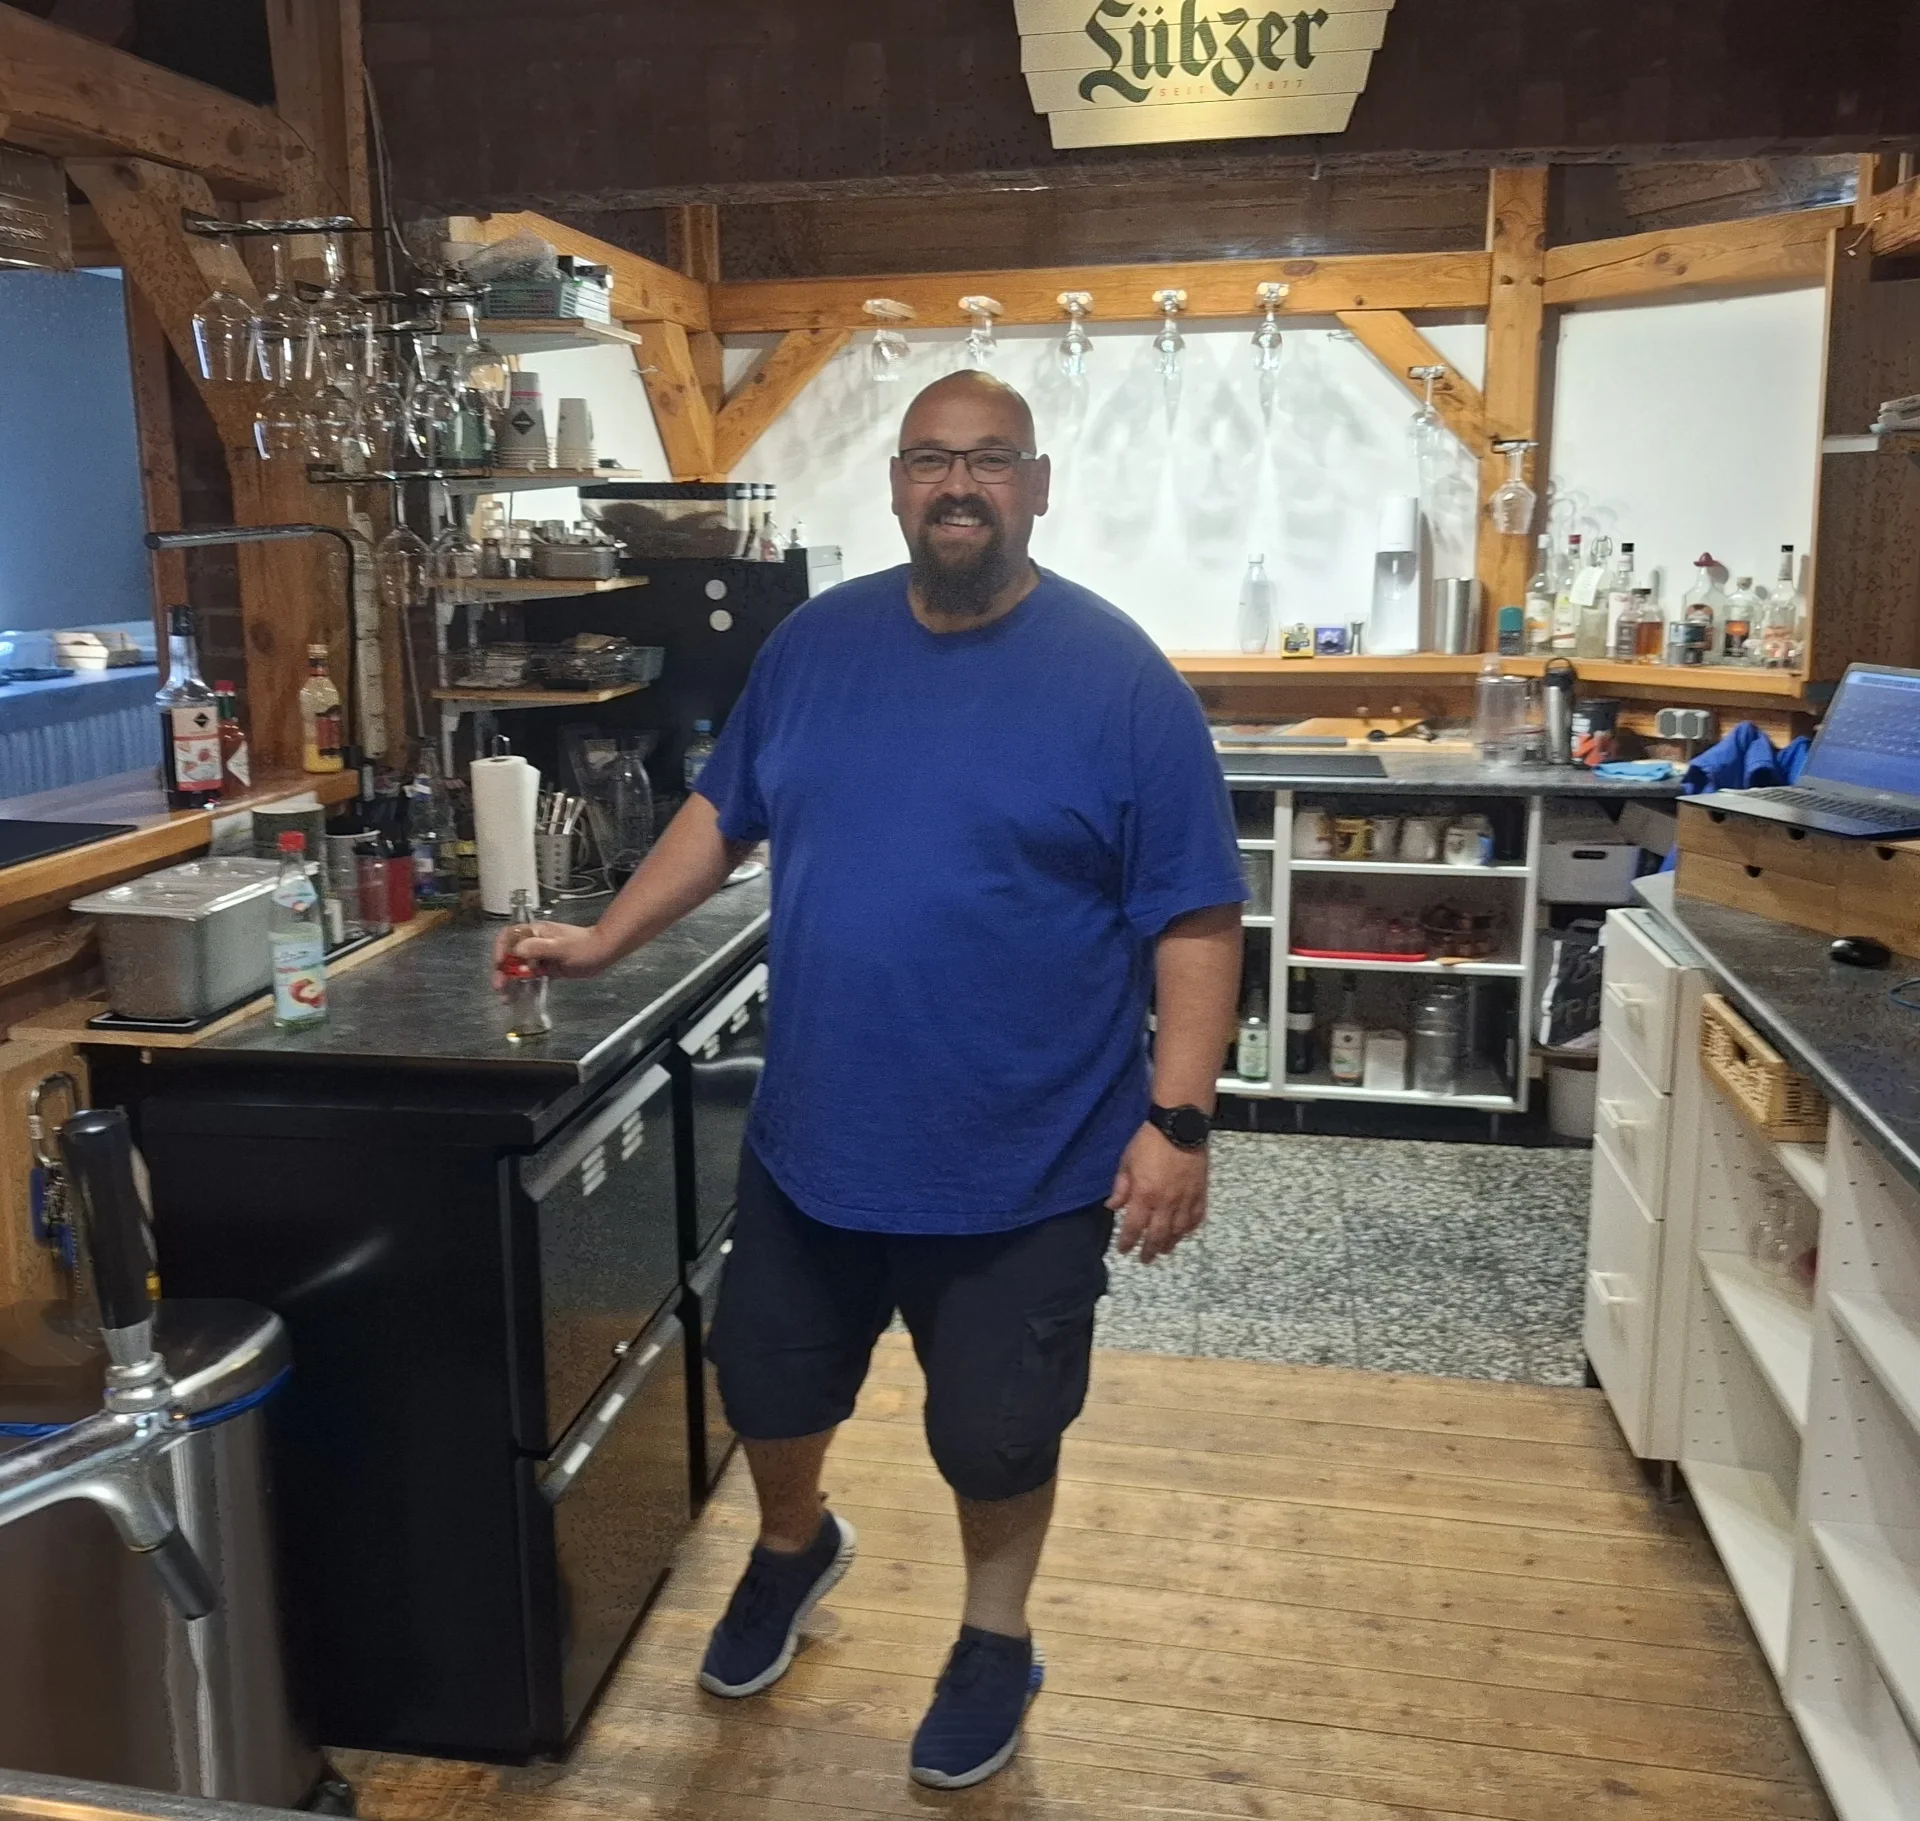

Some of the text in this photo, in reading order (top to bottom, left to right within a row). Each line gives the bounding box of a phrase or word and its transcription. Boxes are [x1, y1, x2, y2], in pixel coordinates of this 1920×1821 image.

[1078, 0, 1329, 104] Lübzer
[1159, 79, 1304, 97] SEIT 1877
